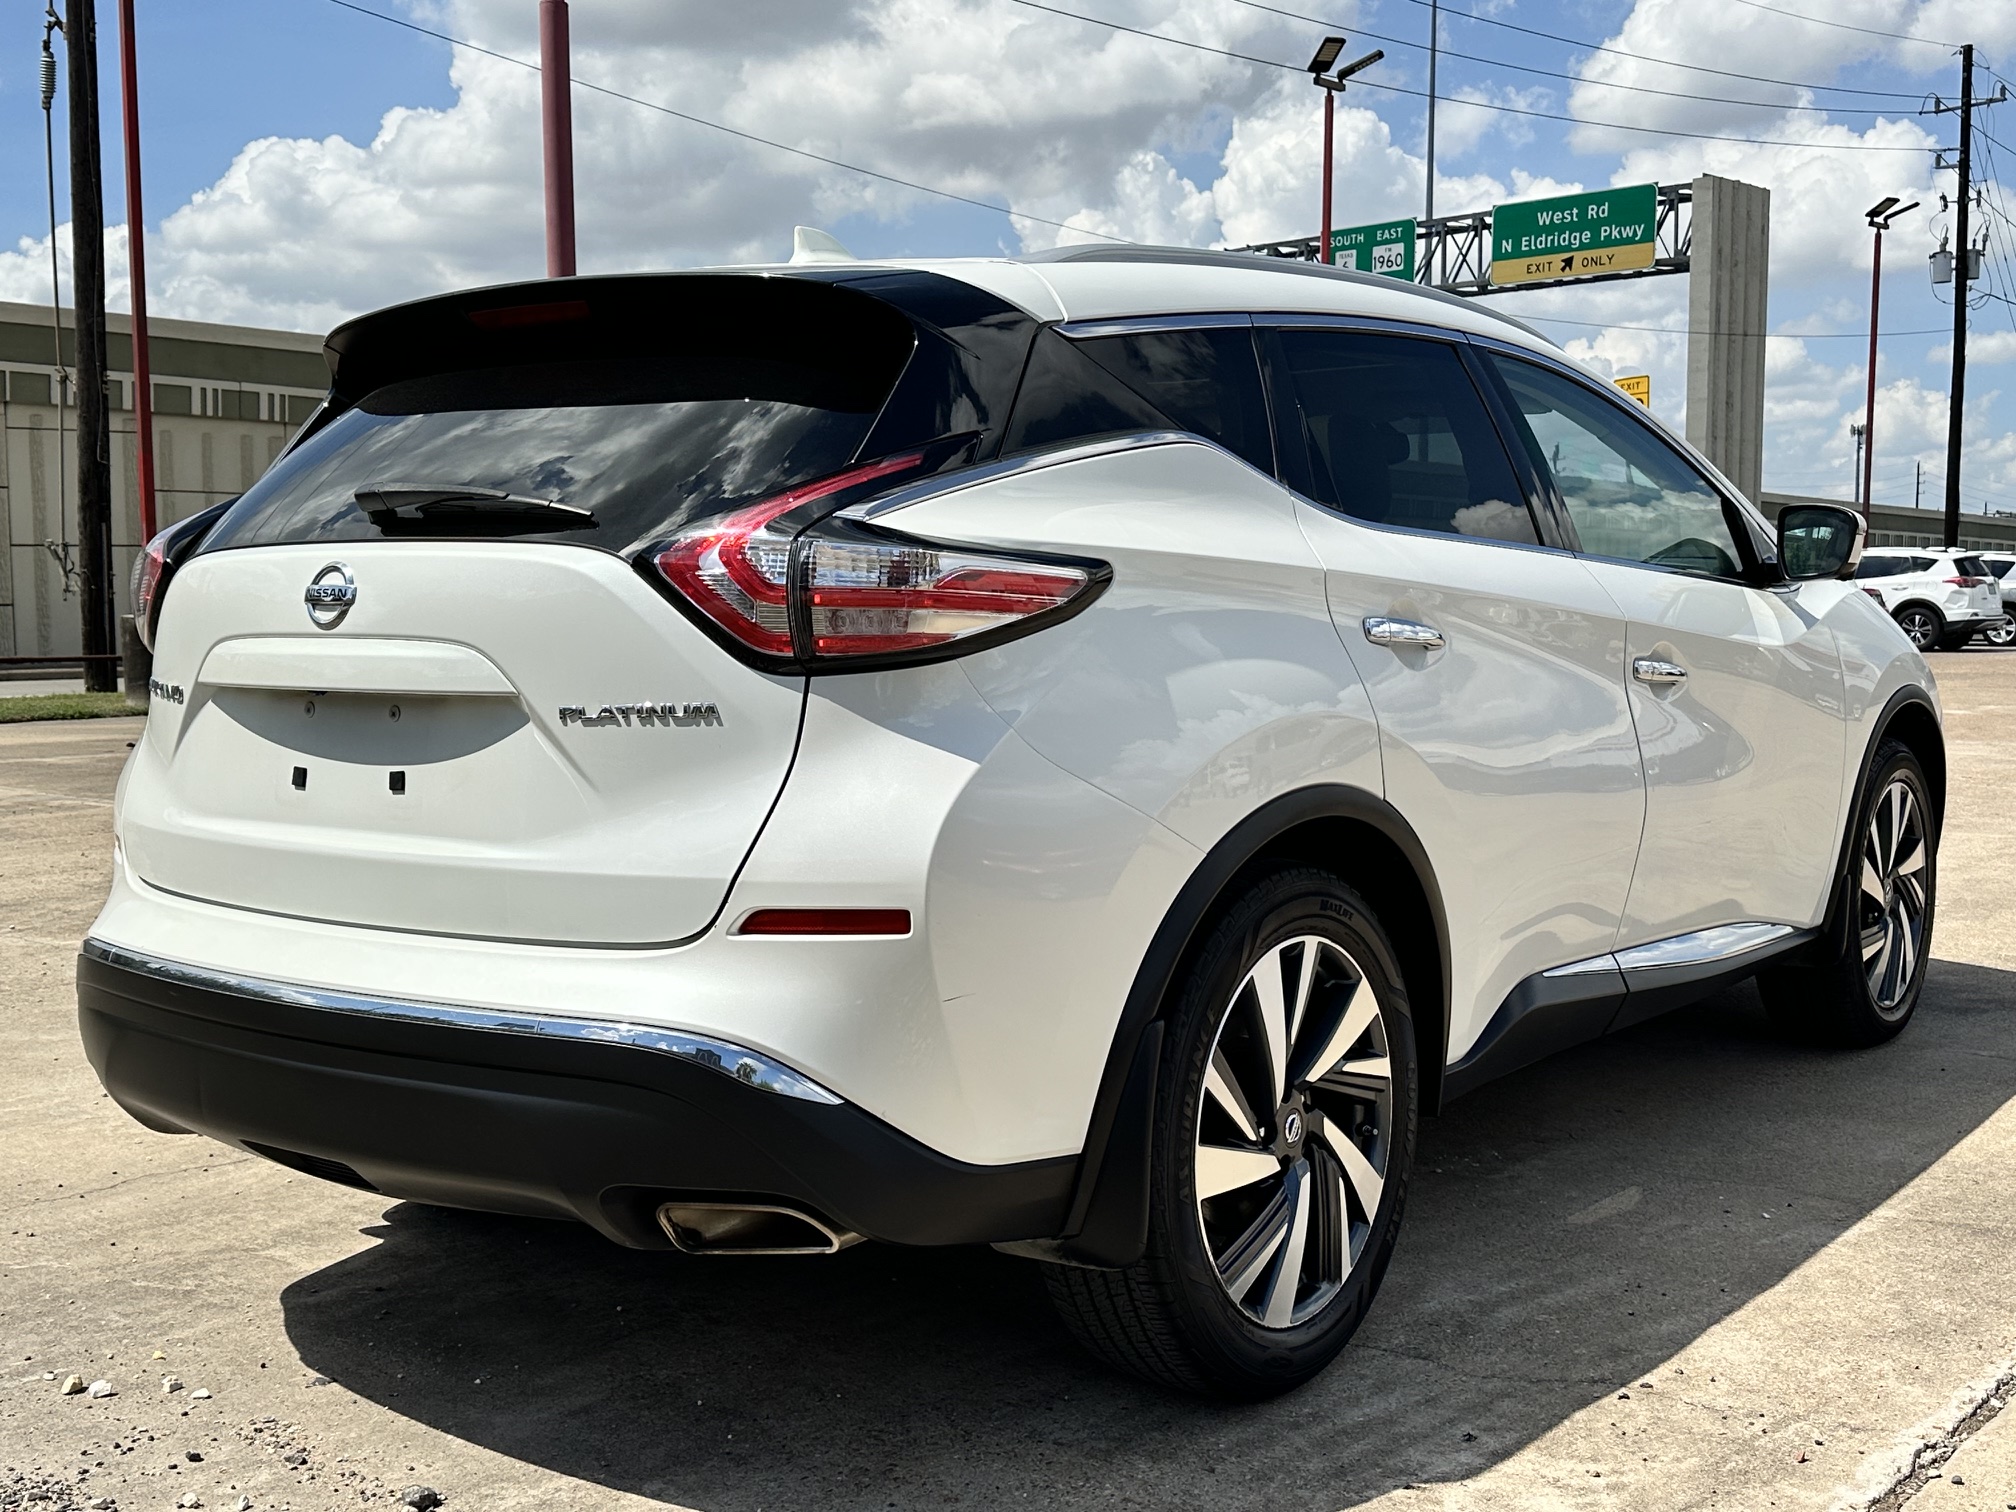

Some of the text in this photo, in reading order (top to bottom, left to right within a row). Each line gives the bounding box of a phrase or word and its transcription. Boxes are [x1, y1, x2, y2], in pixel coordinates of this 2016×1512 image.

[1537, 202, 1608, 226] West Rd
[1330, 227, 1403, 247] SOUTH EAST
[1501, 224, 1645, 253] N Eldridge Pkwy
[1373, 252, 1403, 270] 1960
[1526, 254, 1615, 274] EXIT ONLY
[306, 587, 347, 598] NISSAN
[558, 701, 721, 722] PLATINUM
